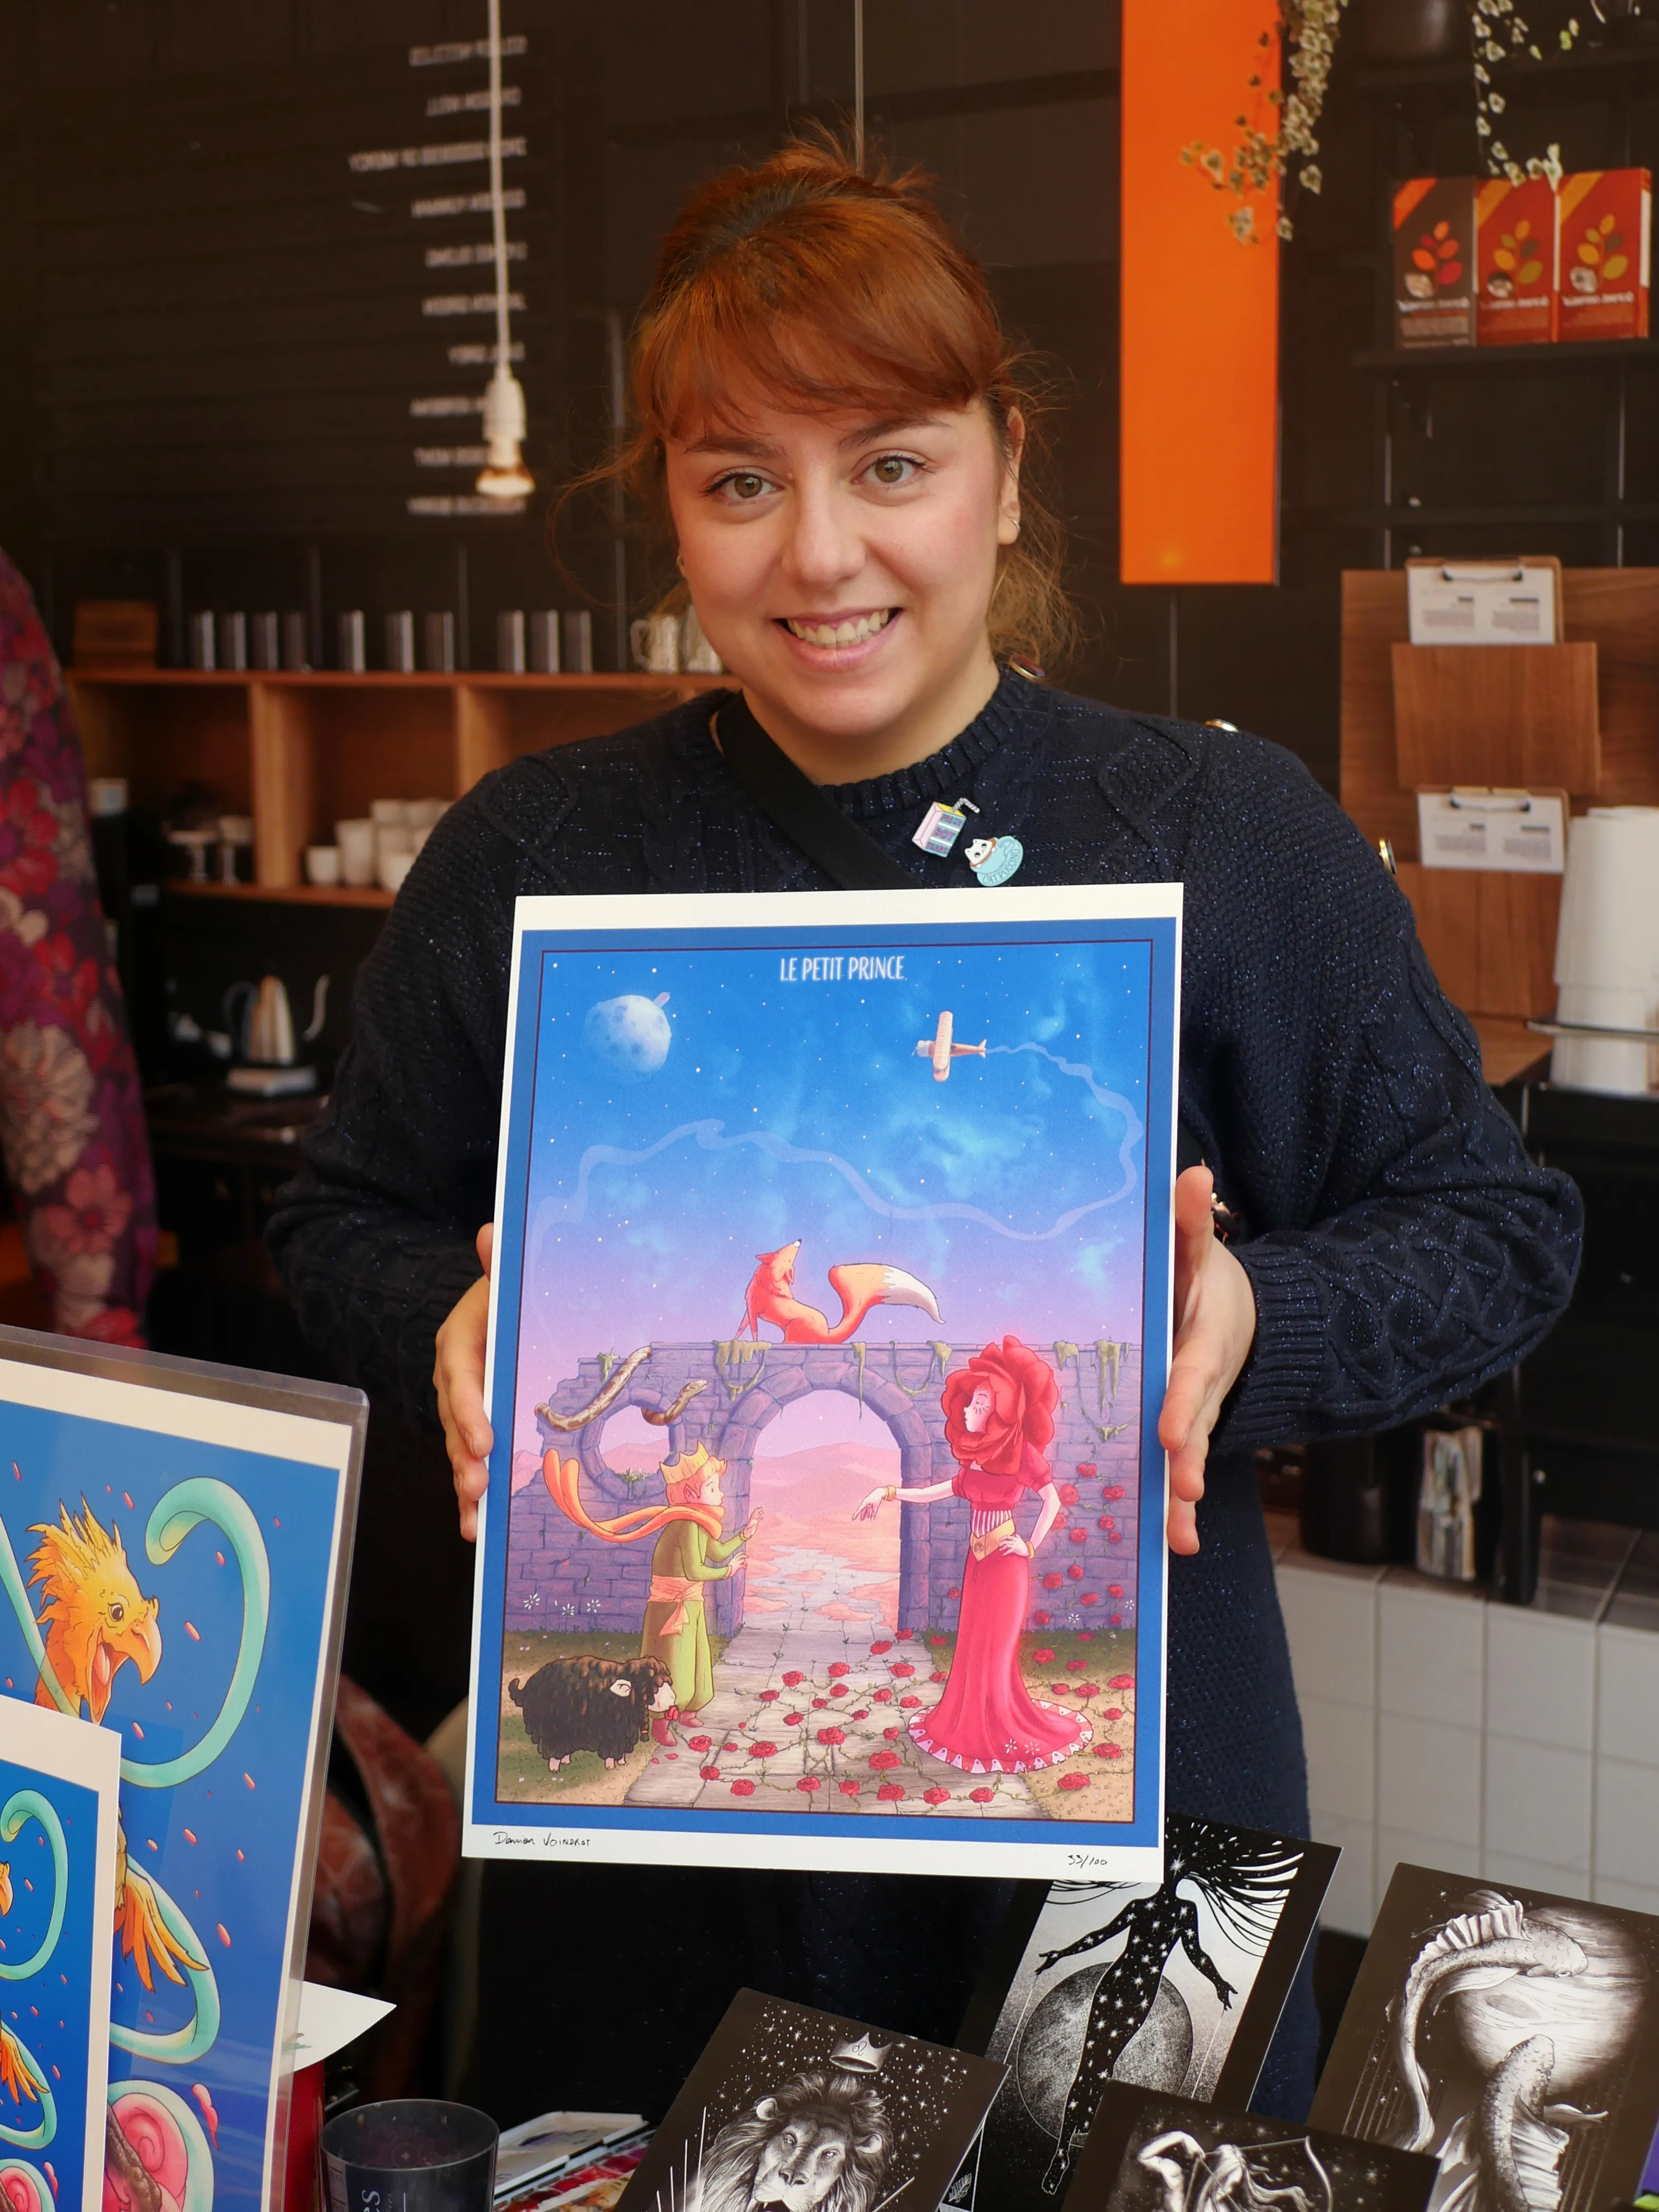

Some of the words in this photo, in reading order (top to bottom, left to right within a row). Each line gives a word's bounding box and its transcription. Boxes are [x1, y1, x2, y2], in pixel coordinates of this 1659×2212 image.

[934, 827, 956, 841] BOY
[983, 849, 1020, 885] CATPUCCINO
[780, 957, 798, 981] LE
[802, 956, 844, 981] PETIT
[848, 955, 905, 980] PRINCE
[1067, 1854, 1108, 1869] 33/100
